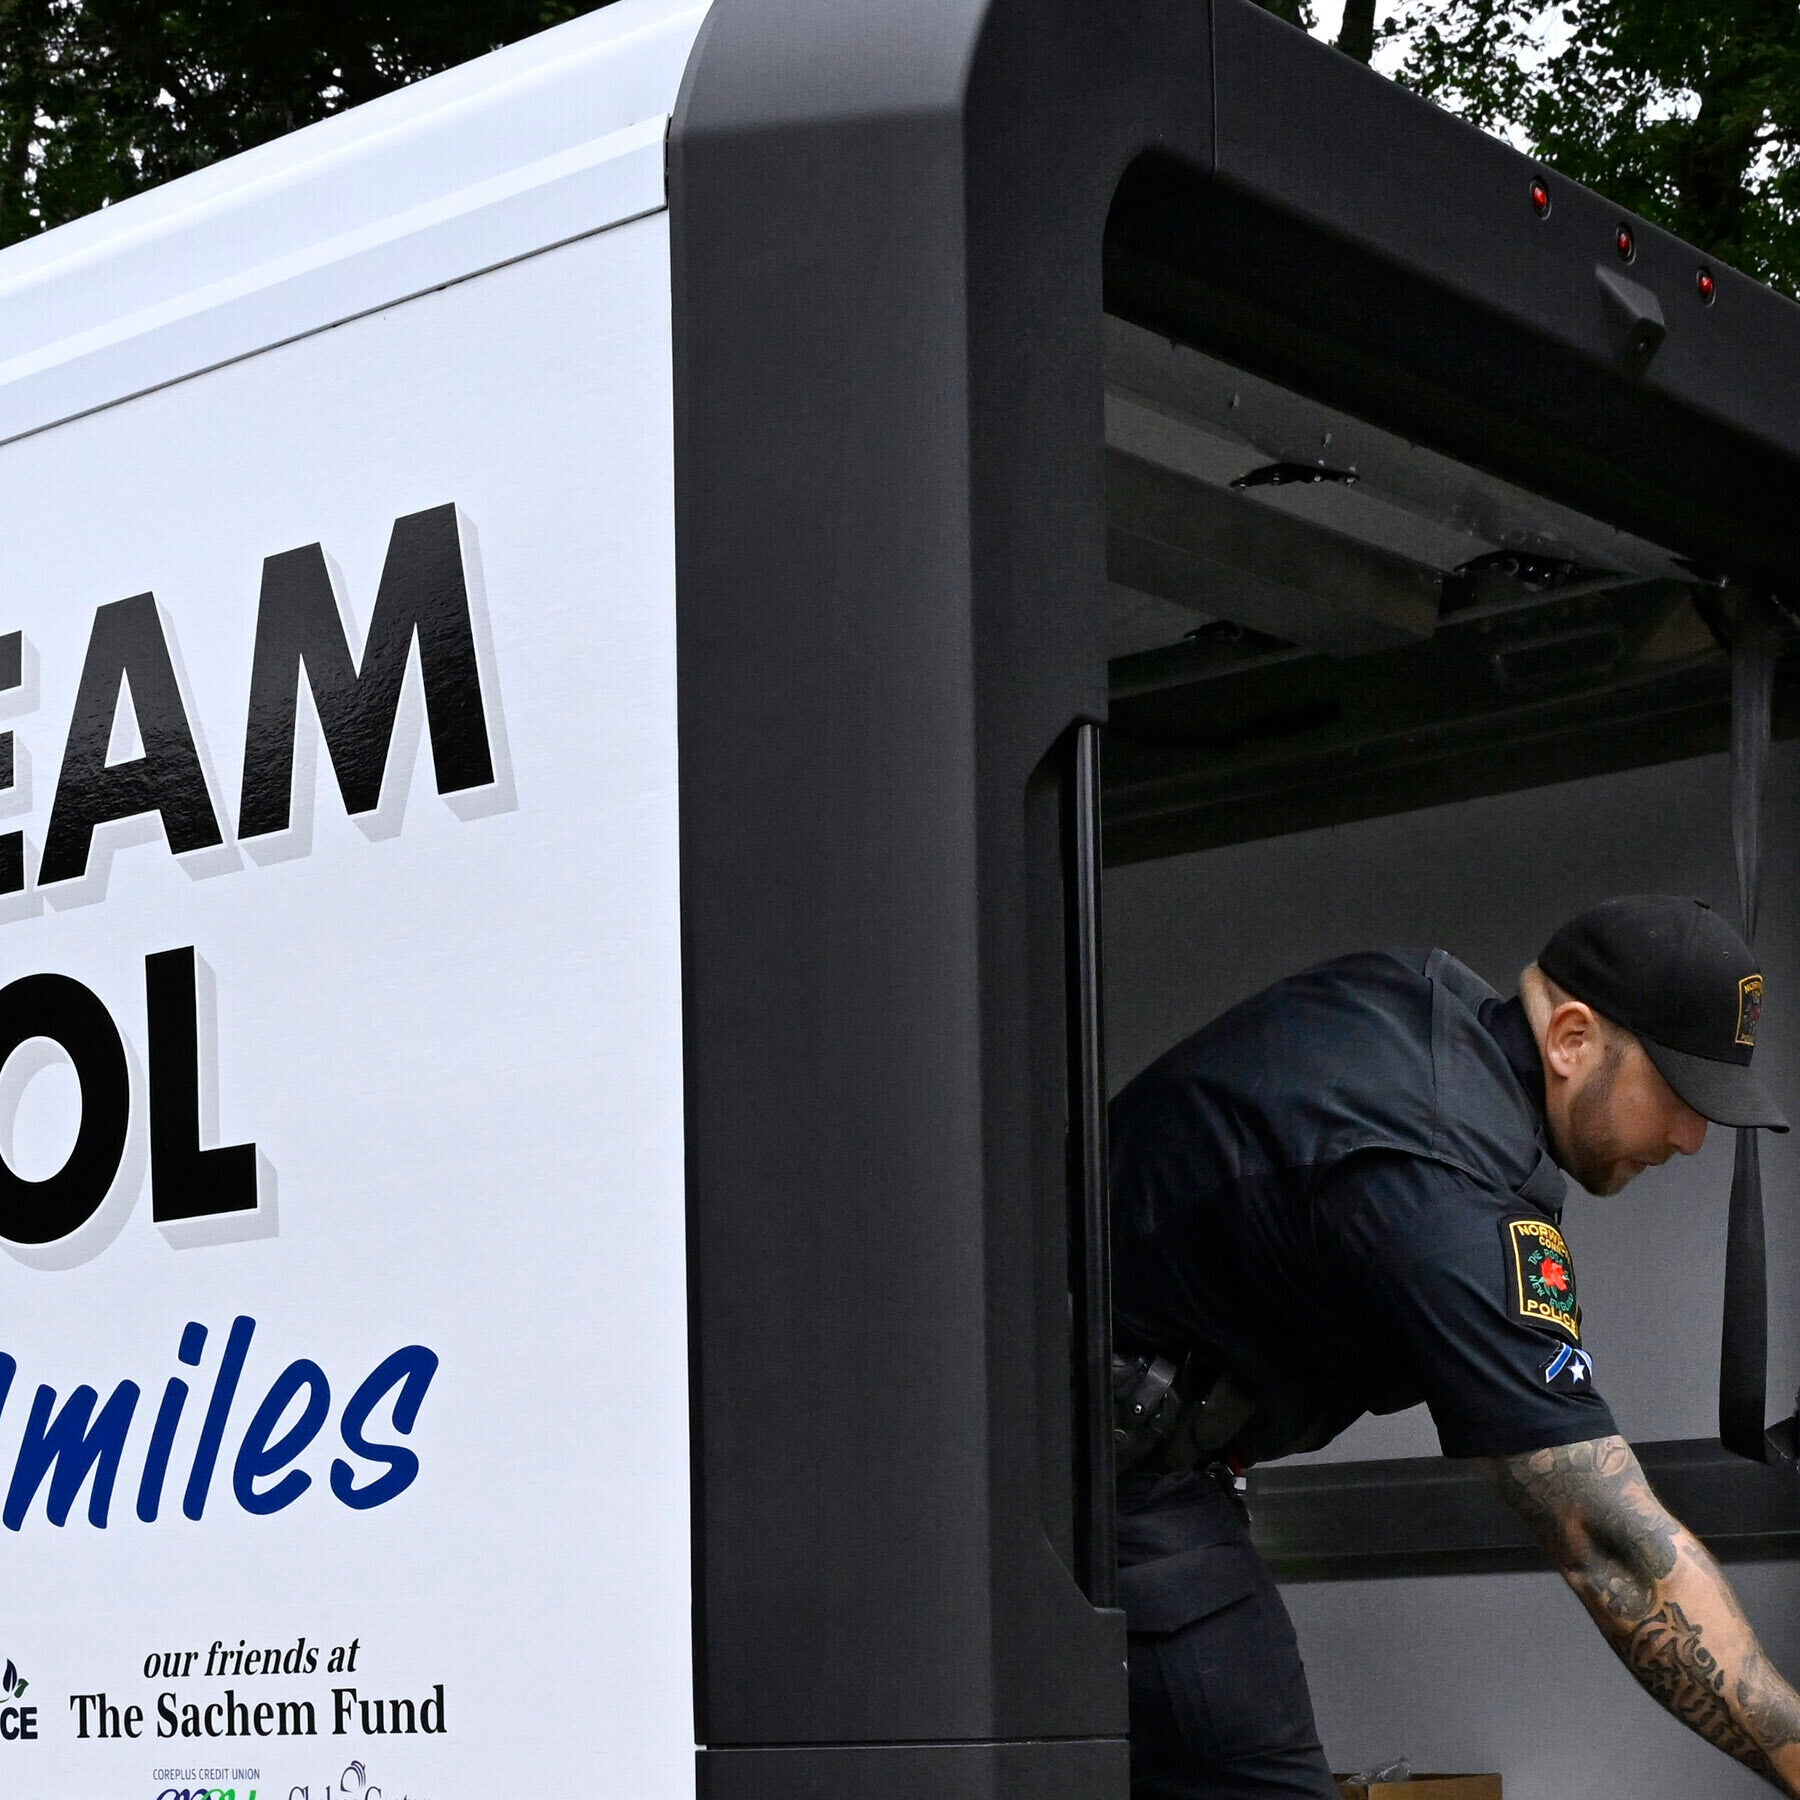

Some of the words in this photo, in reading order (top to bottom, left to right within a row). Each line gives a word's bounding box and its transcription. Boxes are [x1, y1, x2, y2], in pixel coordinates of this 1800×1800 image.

[143, 1649, 198, 1678] our
[204, 1637, 319, 1678] friends
[326, 1637, 361, 1673] at
[70, 1692, 144, 1739] The
[156, 1689, 318, 1739] Sachem
[331, 1684, 448, 1735] Fund
[153, 1768, 197, 1781] COREPLUS
[199, 1768, 229, 1780] CREDIT
[232, 1768, 261, 1780] UNION
